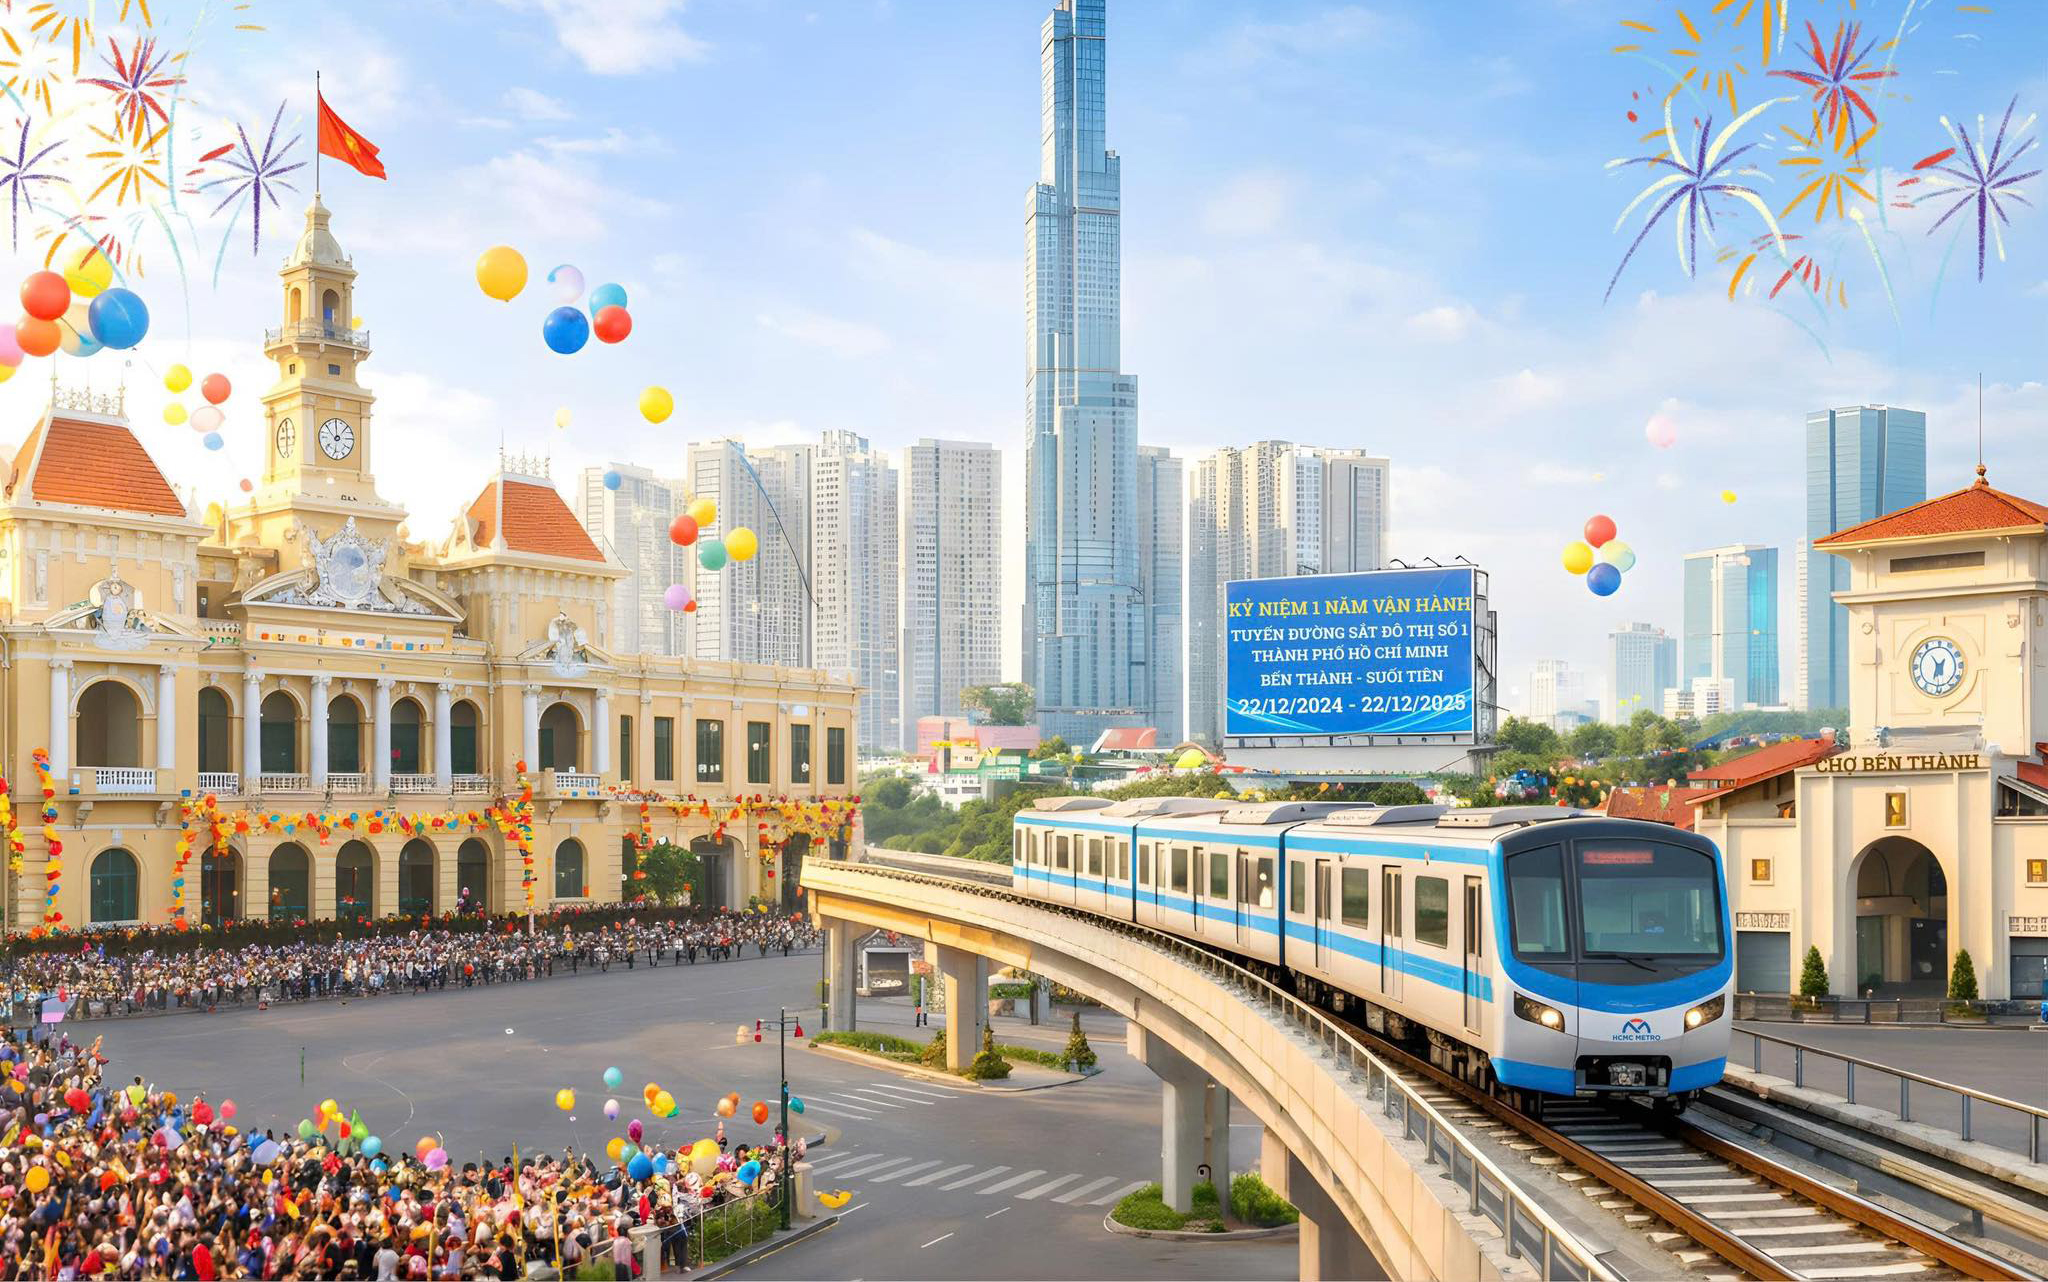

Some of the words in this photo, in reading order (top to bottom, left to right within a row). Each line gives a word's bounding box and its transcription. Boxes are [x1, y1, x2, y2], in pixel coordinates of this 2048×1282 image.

[1229, 597, 1254, 617] KỶ
[1258, 597, 1308, 618] NIỆM
[1312, 601, 1320, 615] 1
[1325, 596, 1368, 615] NĂM
[1372, 595, 1411, 616] VẬN
[1415, 594, 1471, 613] HÀNH
[1230, 625, 1285, 642] TUYẾN
[1288, 624, 1345, 641] ĐƯỜNG
[1381, 622, 1403, 638] ĐÔ
[1406, 624, 1434, 640] THỊ
[1438, 620, 1458, 637] SỐ
[1461, 623, 1468, 636] 1
[1251, 646, 1309, 663] THÀNH
[1312, 644, 1345, 661] PHỐ
[1348, 643, 1371, 660] HỒ
[1374, 643, 1402, 659] CHÍ
[1405, 645, 1449, 659] MINH
[1260, 670, 1293, 687] BẾN
[1295, 670, 1353, 686] THÀNH
[1366, 667, 1403, 684] SUỐI
[1406, 667, 1444, 683] TIÊN
[1237, 697, 1343, 716] 22/12/2024
[1361, 695, 1466, 713] 22/12/2025
[1815, 756, 1858, 776] CHỢ
[1862, 751, 1903, 772] BẾN
[1906, 751, 1979, 771] THÀNH
